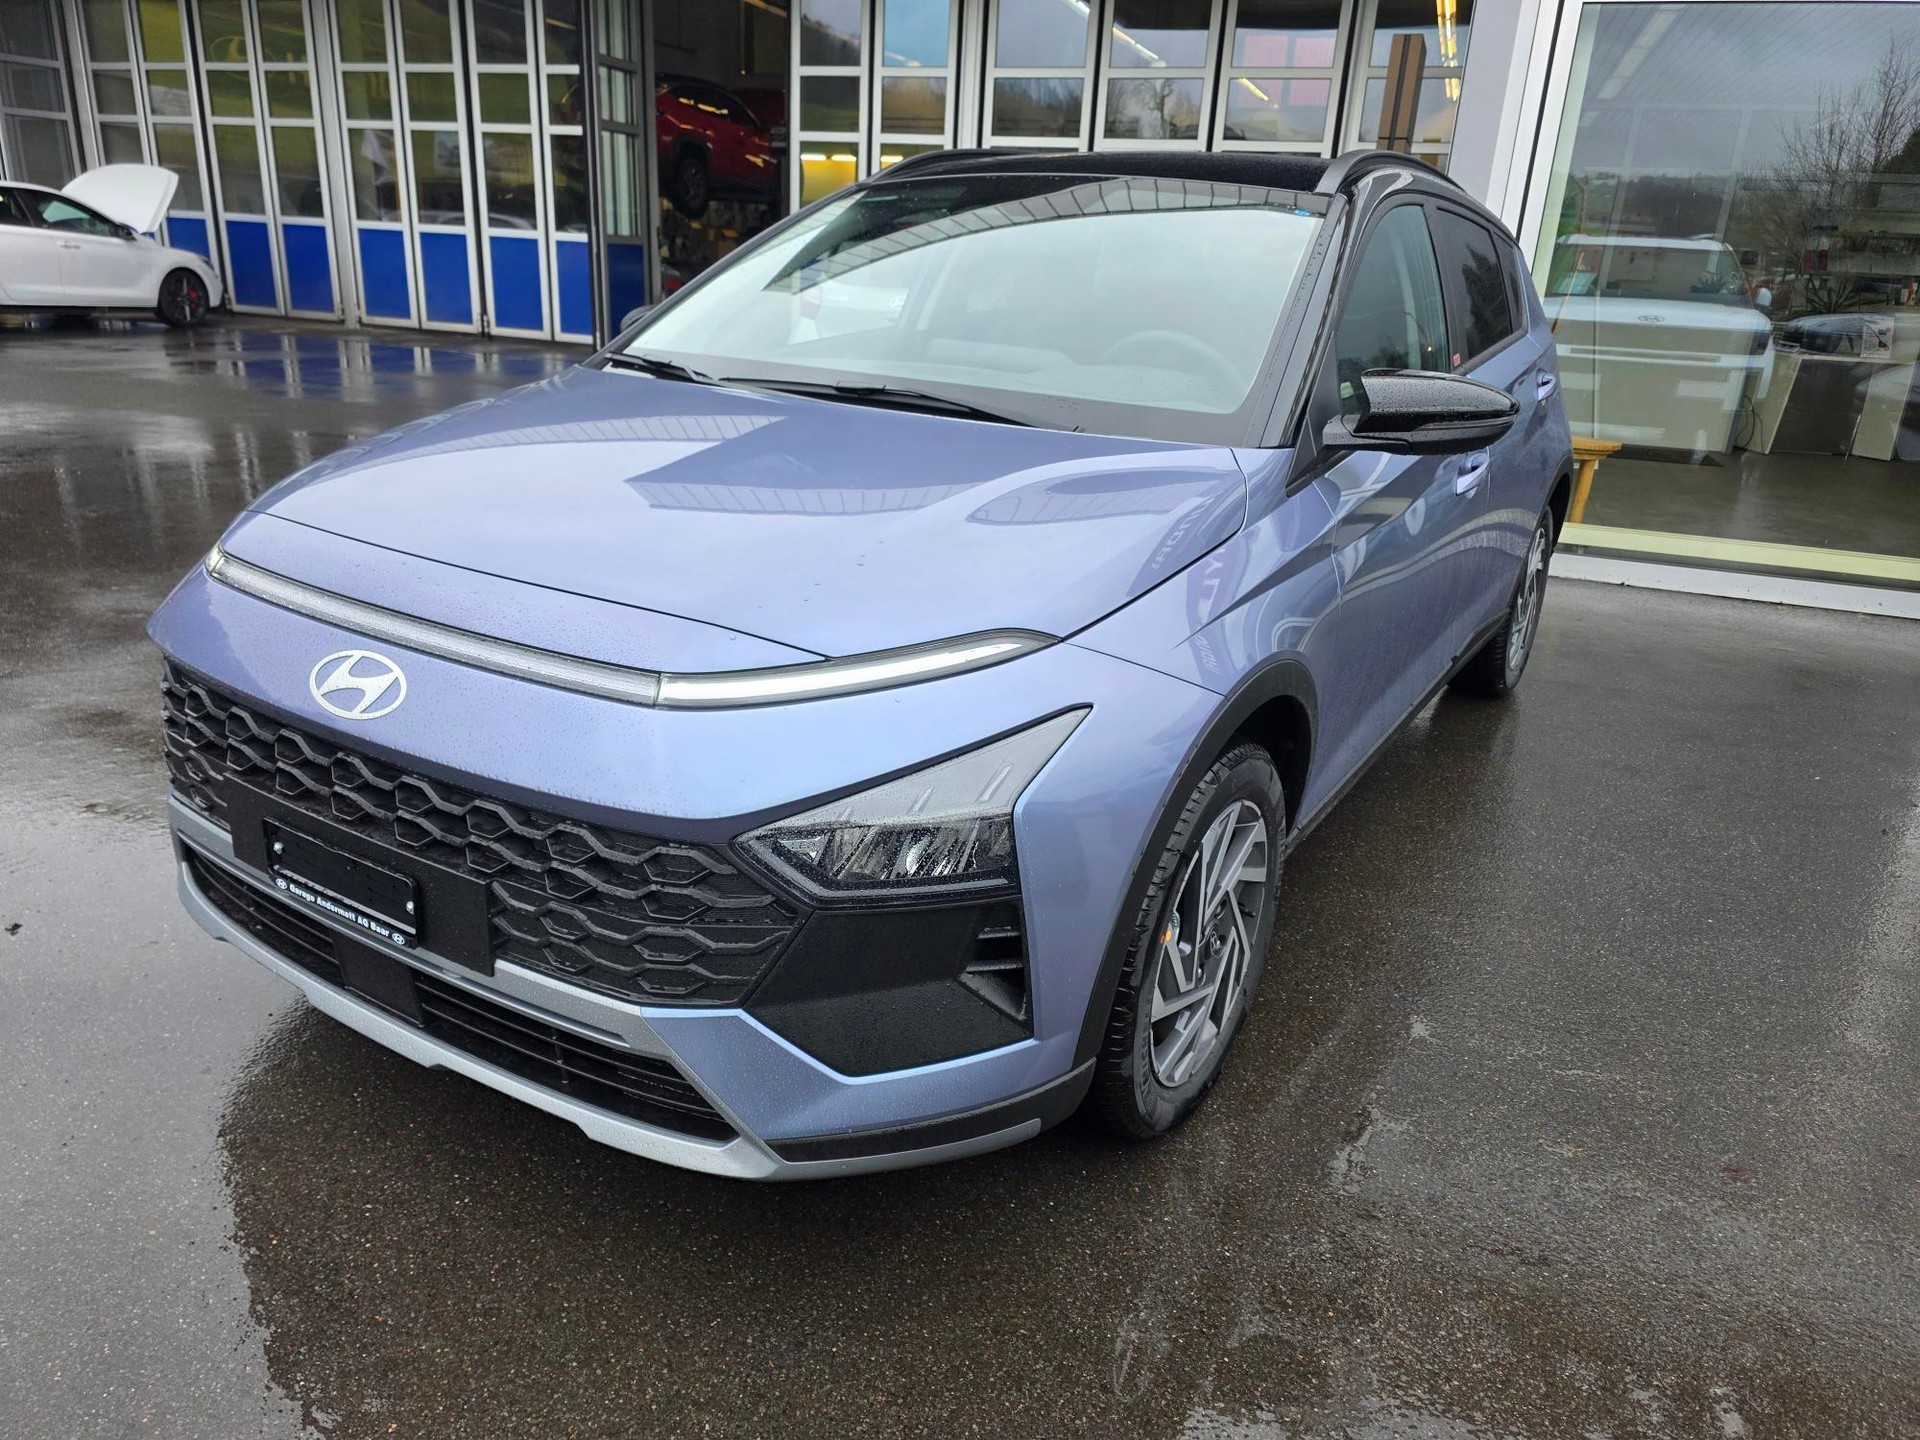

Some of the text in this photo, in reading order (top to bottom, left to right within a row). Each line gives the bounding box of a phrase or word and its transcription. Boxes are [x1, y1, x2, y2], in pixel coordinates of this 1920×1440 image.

[289, 883, 390, 937] Garage Andermatt AG Baar
